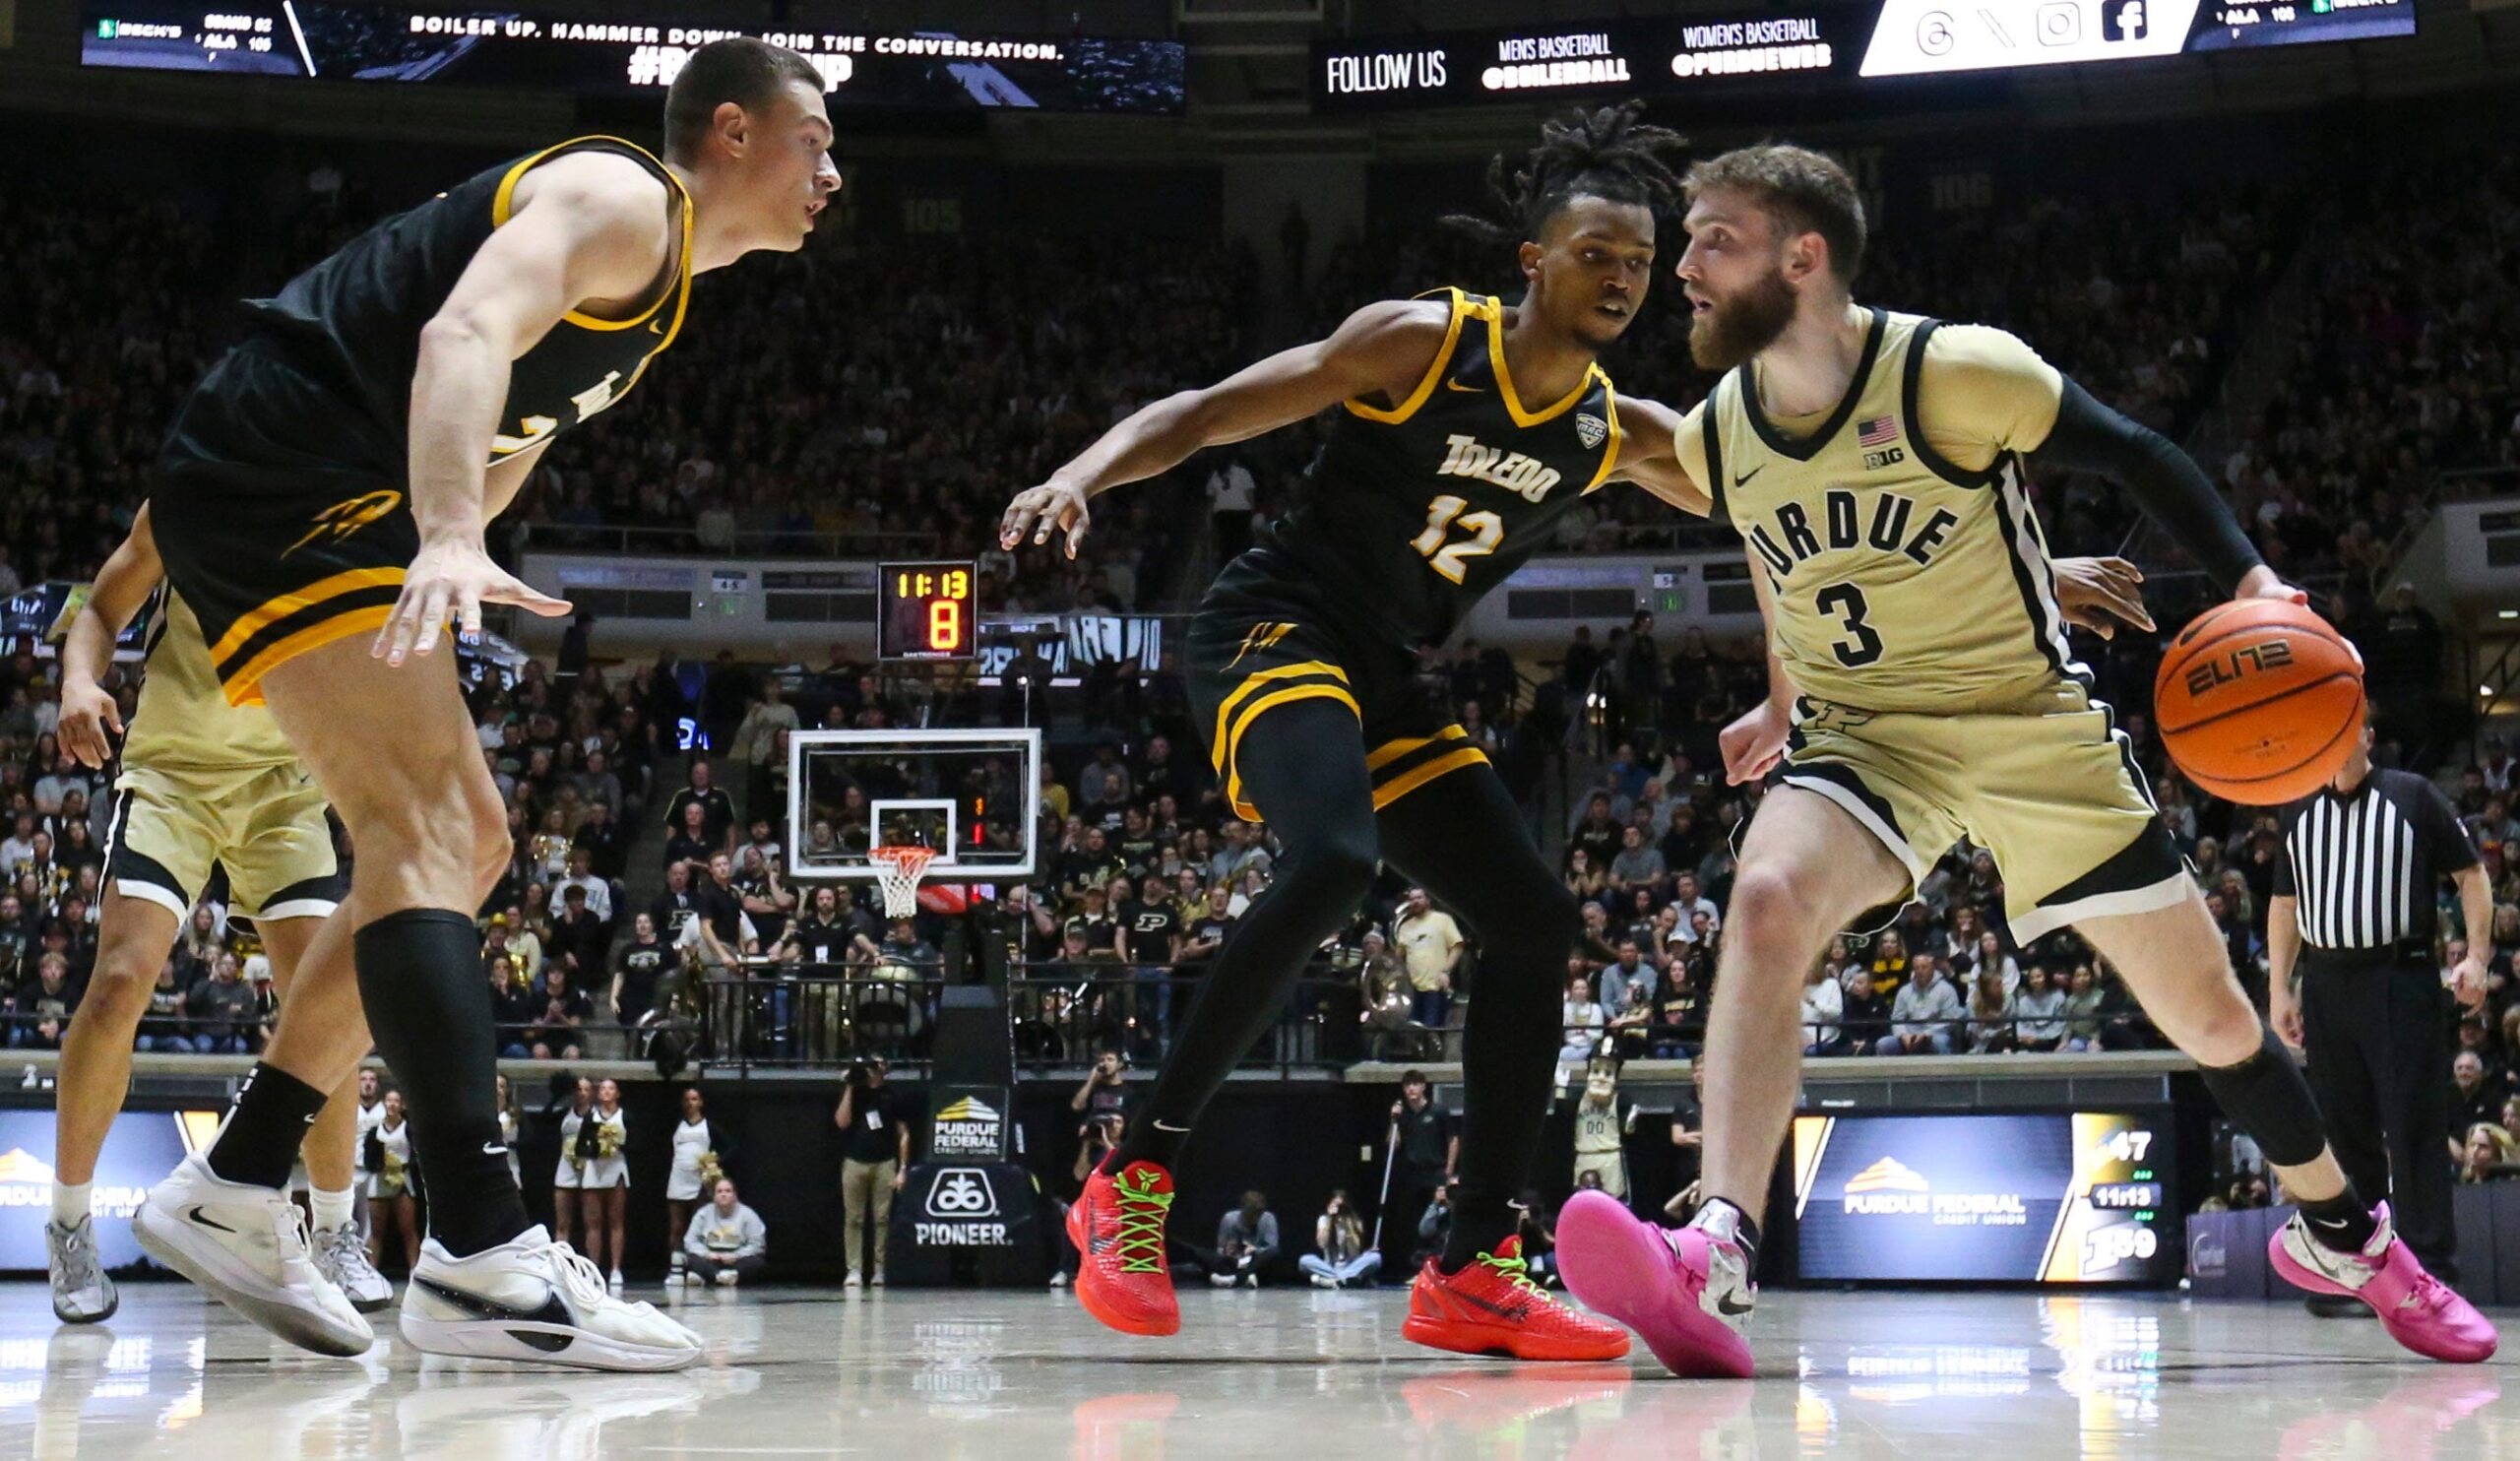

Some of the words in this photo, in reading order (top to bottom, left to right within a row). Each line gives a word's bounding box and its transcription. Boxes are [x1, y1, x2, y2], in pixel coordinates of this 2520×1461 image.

[1683, 25, 1742, 48] WOMEN'S
[1746, 18, 1819, 44] BASKETBALL
[2226, 9, 2260, 25] ALA
[203, 33, 237, 49] ALA
[410, 16, 496, 35] BOILER
[505, 21, 541, 37] UP.
[551, 24, 659, 43] HAMMER
[822, 35, 866, 52] THE
[874, 37, 1064, 60] CONVERSATION.
[1499, 38, 1536, 61] MEN'S
[1539, 33, 1611, 58] BASKETBALL
[1328, 55, 1412, 93] FOLLOW
[1418, 51, 1446, 89] US
[1482, 58, 1630, 90] @BOILERBALL
[1671, 43, 1832, 77] @PURDUEWBB
[904, 200, 962, 233] 105
[1436, 434, 1561, 503] TOLEDO
[1410, 495, 1504, 586] 12
[1749, 489, 1959, 597] URDUE
[899, 571, 968, 600] 11:13
[930, 600, 959, 650] 8
[1815, 581, 1884, 668] 3
[2185, 638, 2295, 697] ELITE
[935, 1121, 1000, 1136] PURDUE
[935, 1135, 998, 1148] FEDERAL
[2108, 1131, 2153, 1162] 47
[1844, 1194, 1929, 1214] PURDUE
[1932, 1193, 2026, 1214] FEDERAL
[1933, 1214, 1979, 1226] CREDIT
[1983, 1214, 2027, 1226] UNION
